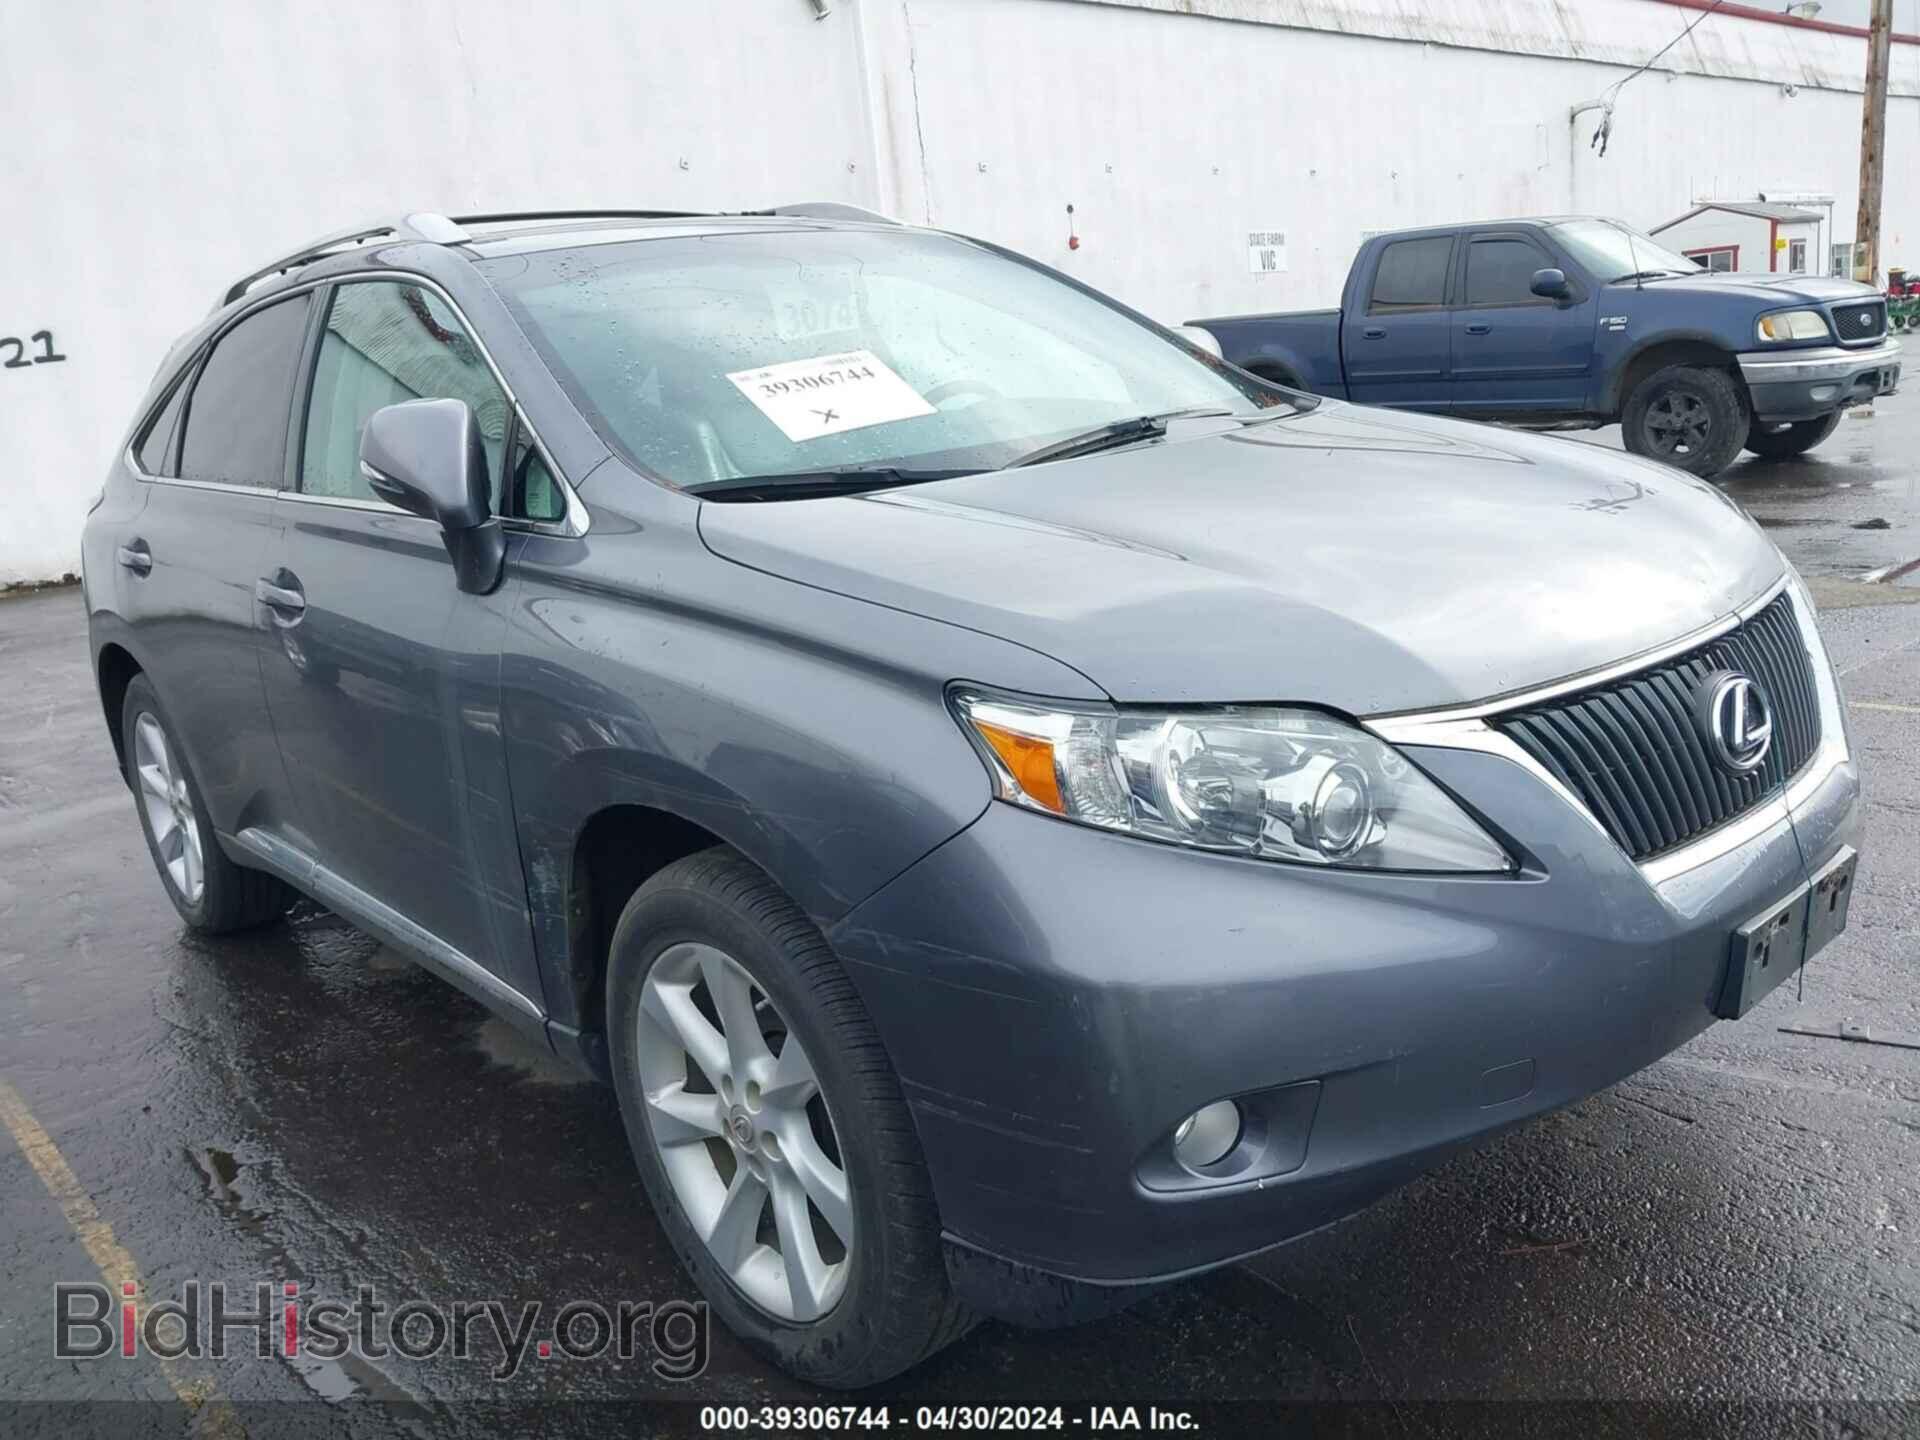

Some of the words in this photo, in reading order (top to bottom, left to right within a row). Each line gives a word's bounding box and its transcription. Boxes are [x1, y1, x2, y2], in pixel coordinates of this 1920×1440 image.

[1248, 232, 1266, 247] STATE
[1266, 232, 1285, 247] FARM
[1260, 249, 1276, 270] VIC
[758, 365, 876, 398] 39306744
